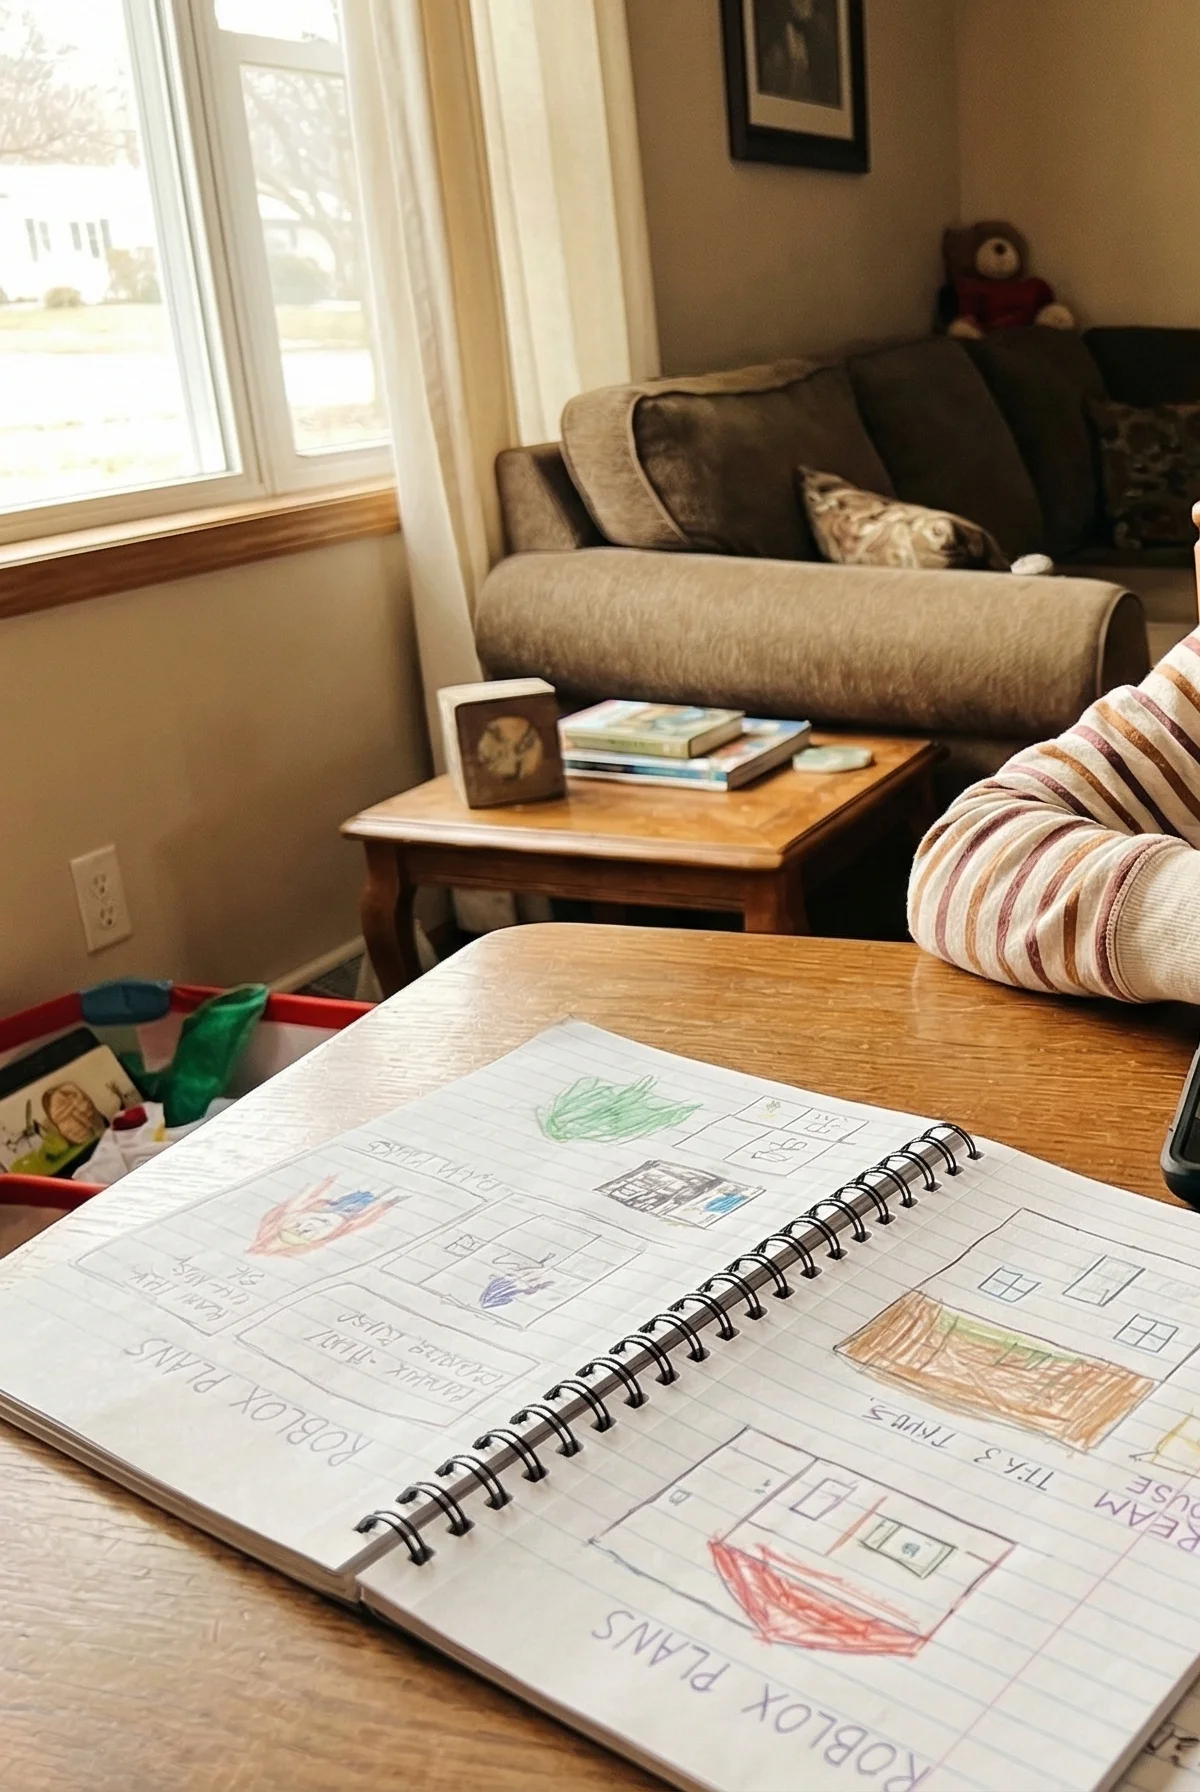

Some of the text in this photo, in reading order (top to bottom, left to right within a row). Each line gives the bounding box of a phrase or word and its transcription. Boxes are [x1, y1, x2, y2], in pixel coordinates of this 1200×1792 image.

[123, 1338, 233, 1395] PLANS
[228, 1384, 375, 1468] ROBLOX
[591, 1609, 931, 1792] ROBLOX PLANS
